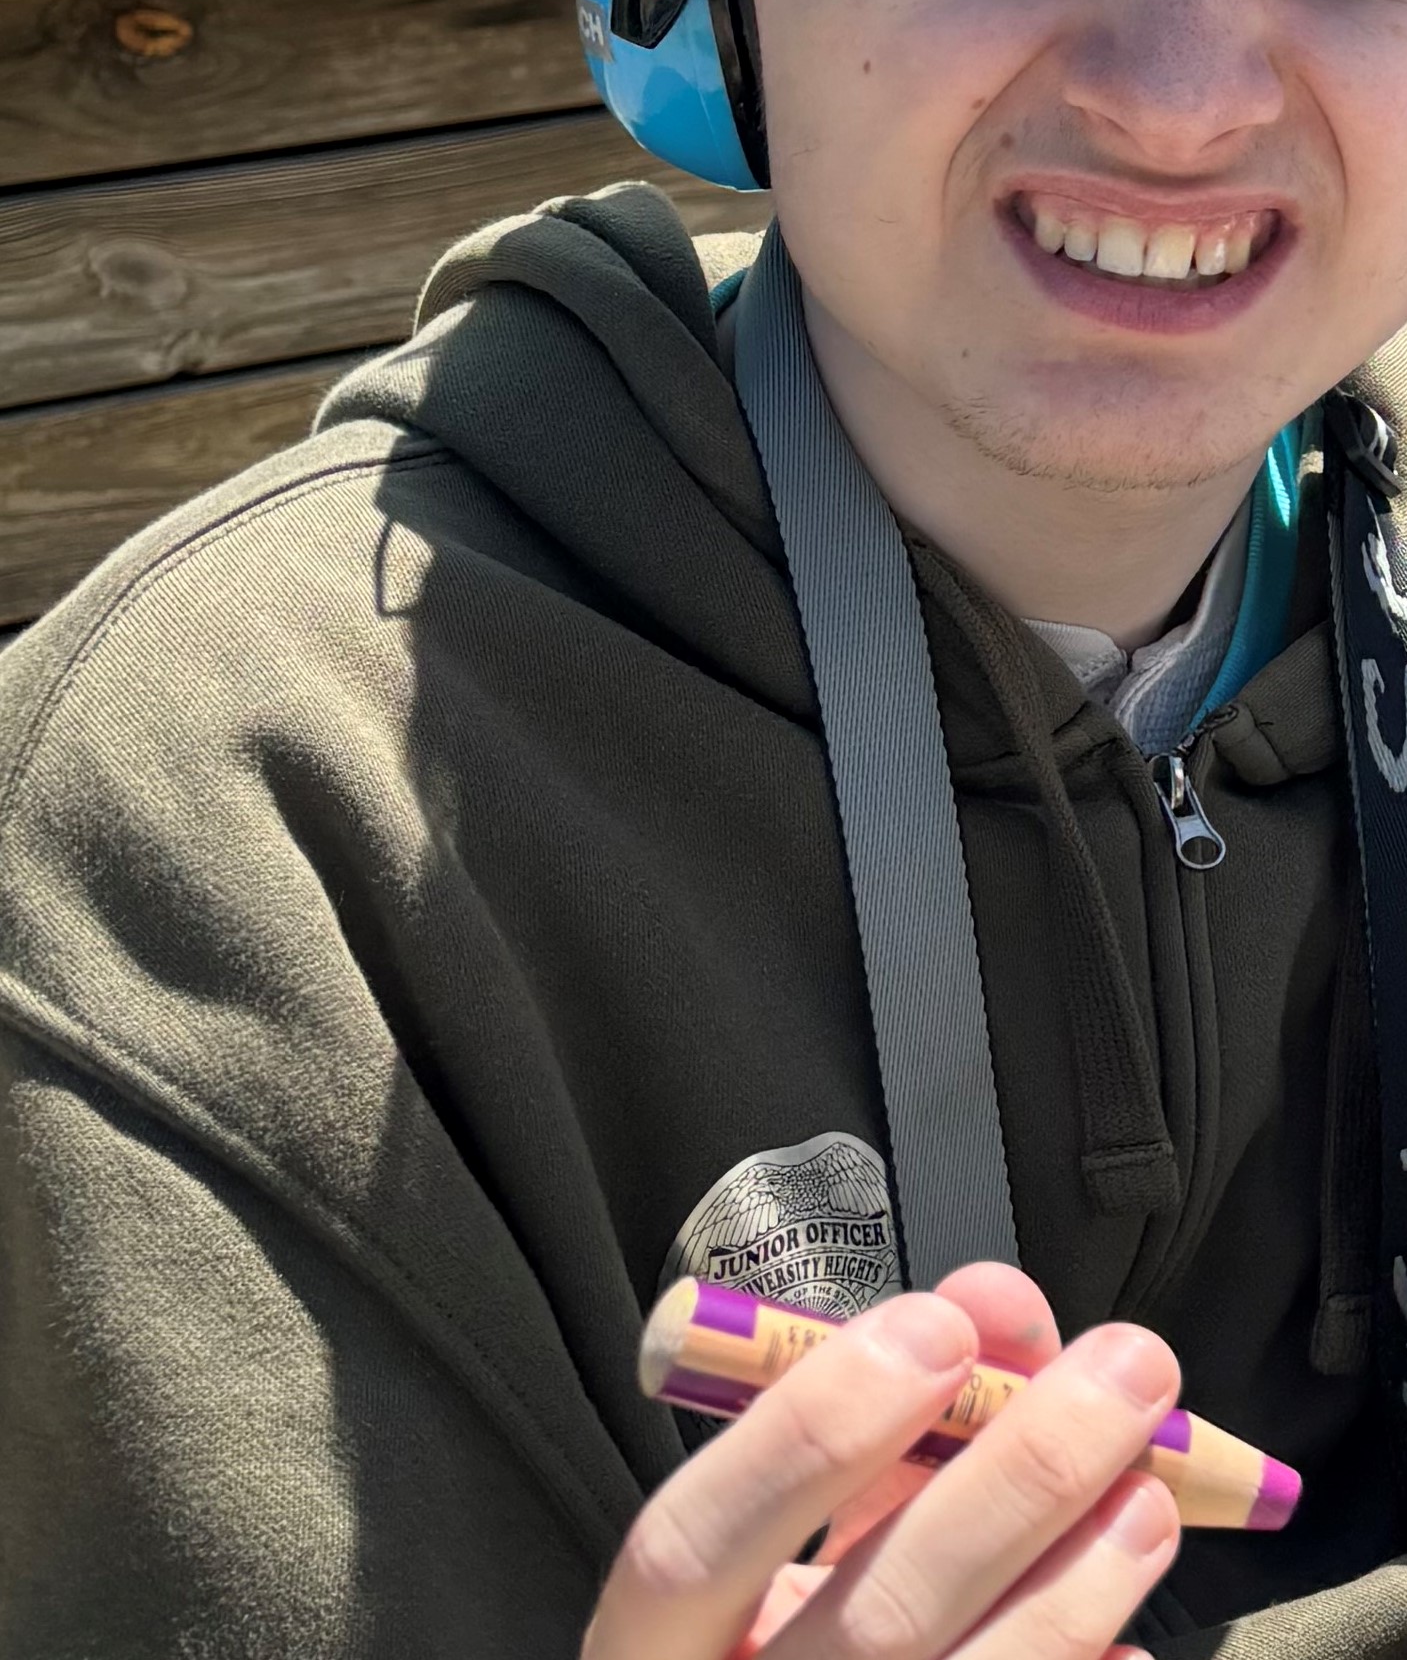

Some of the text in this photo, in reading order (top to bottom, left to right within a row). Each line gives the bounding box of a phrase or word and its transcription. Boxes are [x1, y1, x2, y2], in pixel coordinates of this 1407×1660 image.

[713, 1221, 887, 1280] JUNIOR OFFICER
[741, 1254, 883, 1296] IVERSITY HEIGHTS
